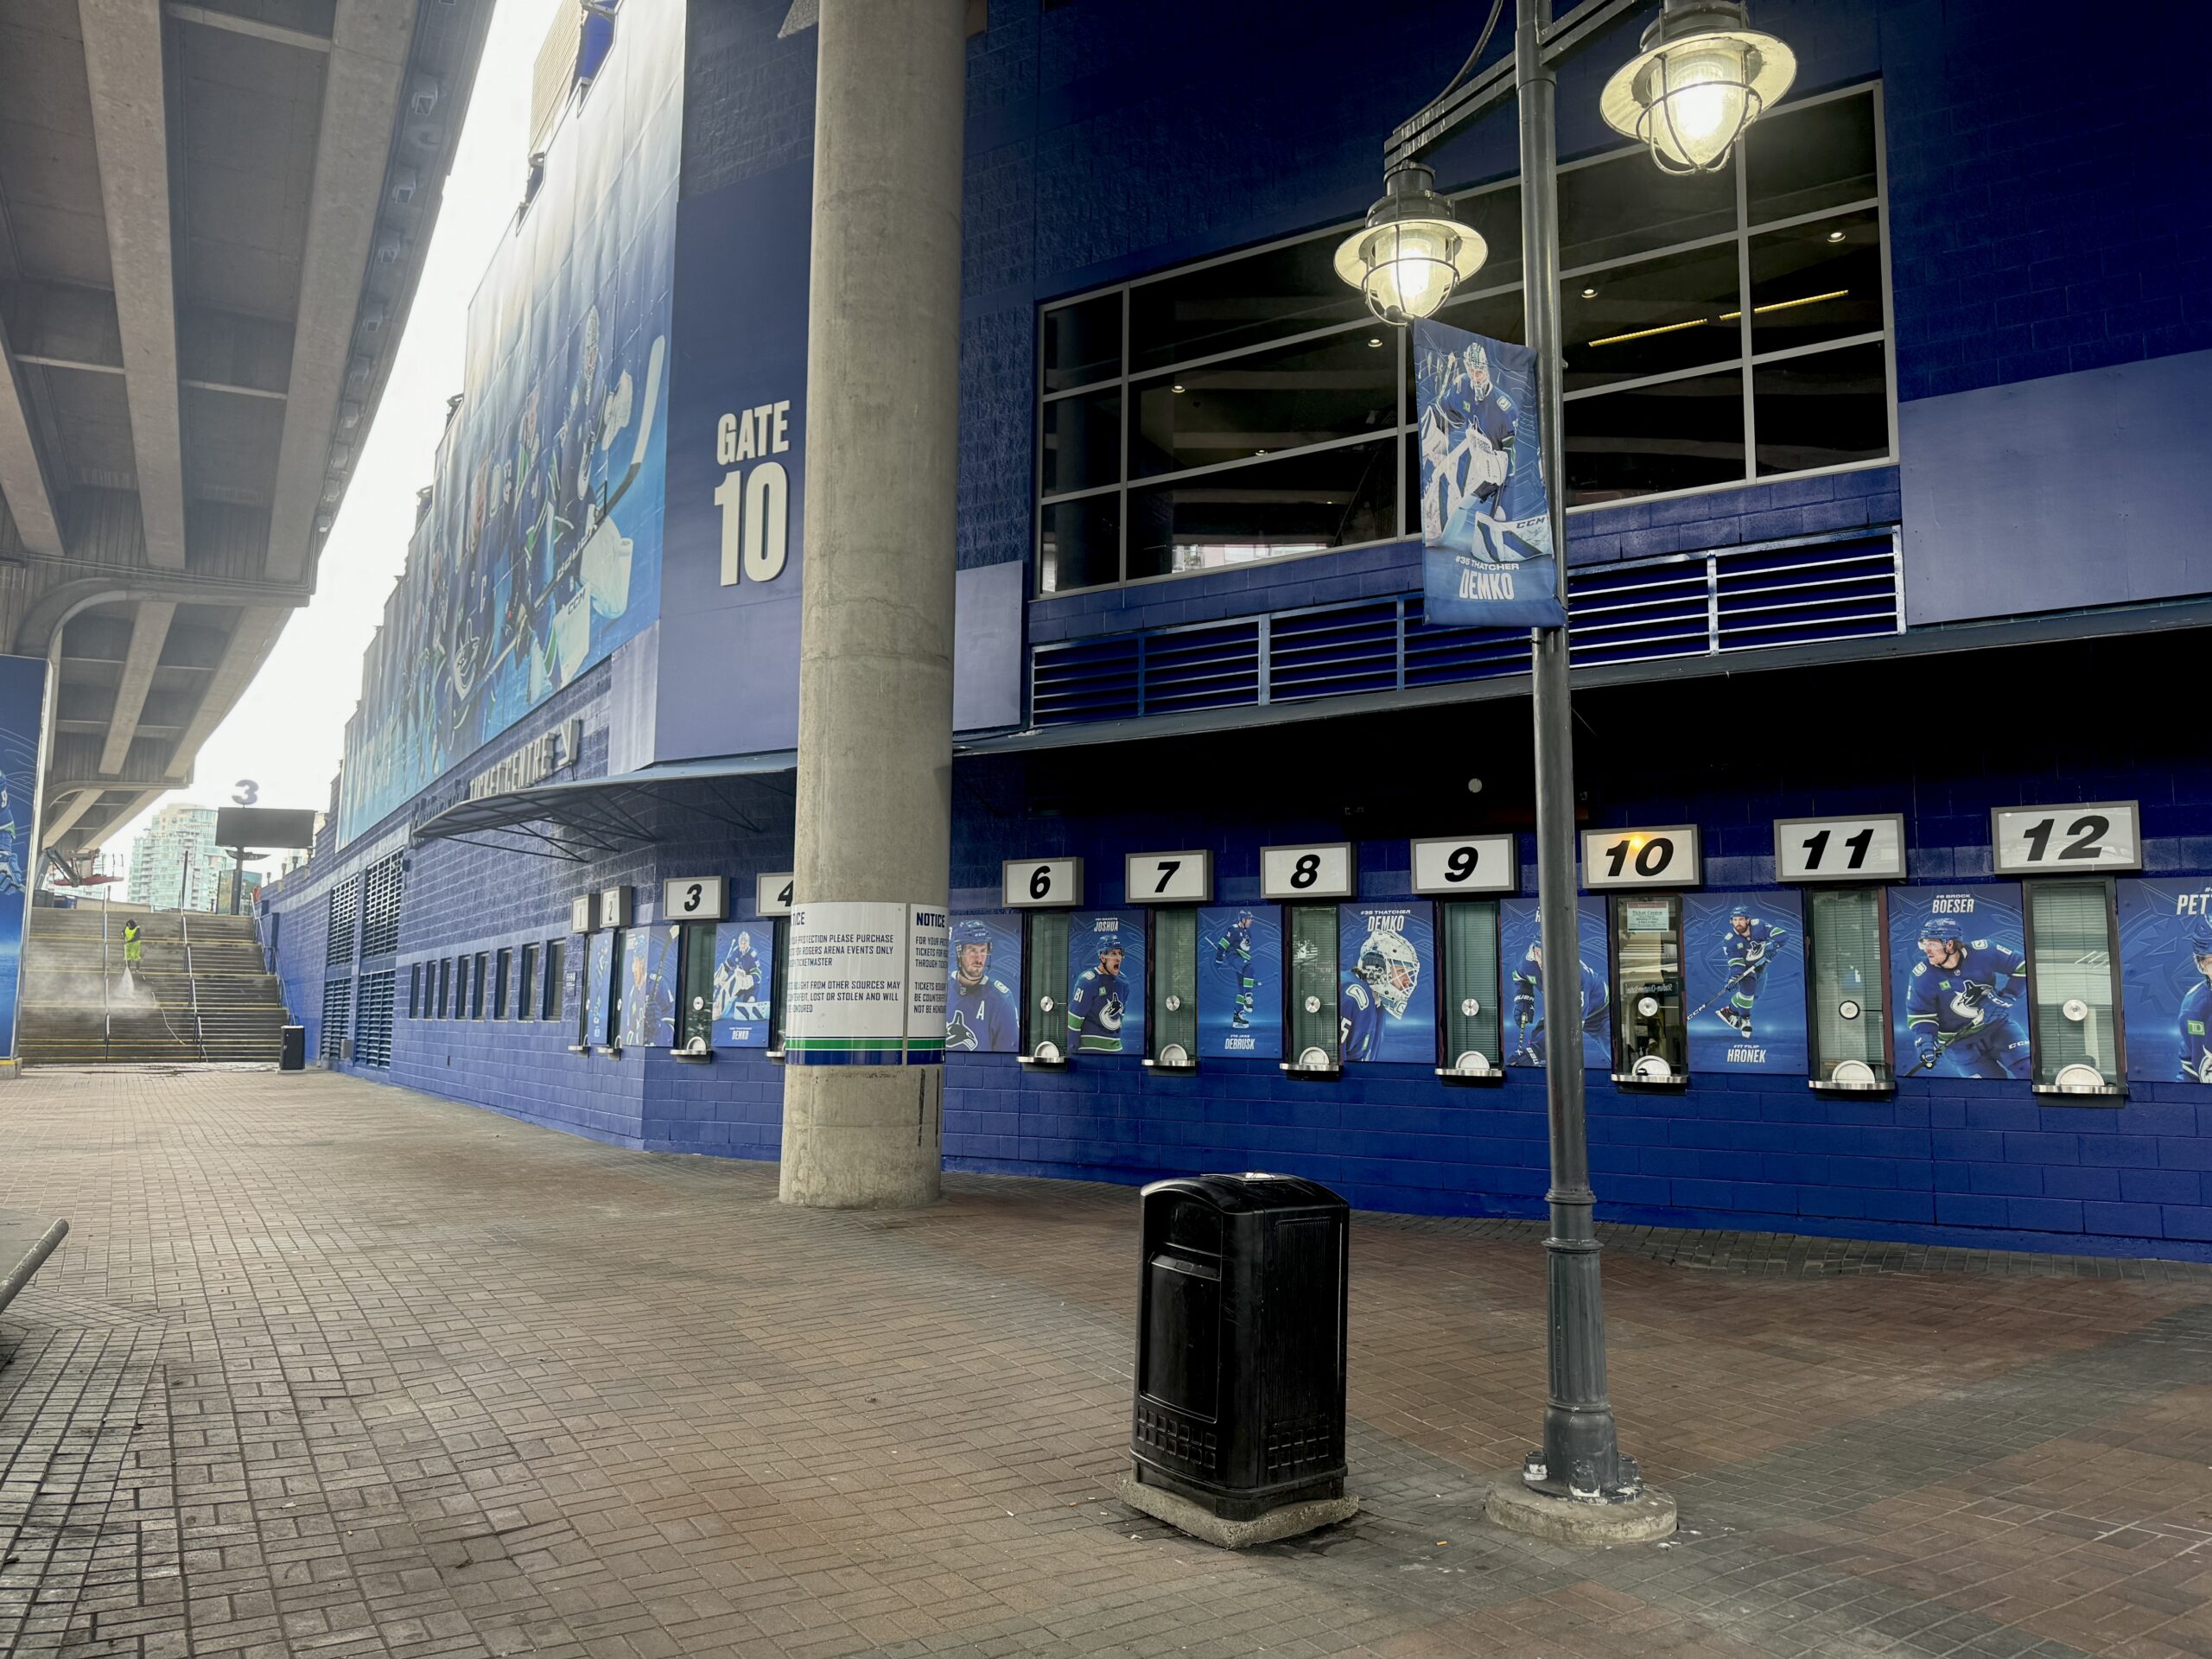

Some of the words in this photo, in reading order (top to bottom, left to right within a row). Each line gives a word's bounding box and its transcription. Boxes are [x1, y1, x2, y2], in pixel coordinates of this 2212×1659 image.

[717, 400, 790, 465] GATE
[715, 461, 787, 586] 10
[1516, 517, 1545, 529] CCM
[1455, 556, 1470, 565] #35
[1471, 557, 1520, 570] THATCHER
[1459, 569, 1515, 600] DEMKO
[505, 732, 555, 791] CENTRE
[231, 779, 259, 805] 3
[2024, 816, 2109, 861] 12
[1606, 838, 1674, 876] 10
[1802, 830, 1873, 869] 11
[1291, 855, 1321, 888] 8
[1445, 847, 1478, 882] 9
[1030, 866, 1052, 899] 6
[1154, 861, 1180, 893] 7
[683, 883, 702, 912] 3
[778, 880, 793, 907] 4
[608, 899, 613, 922] 2
[1932, 899, 1974, 913] BOESER
[2177, 894, 2212, 915] PET
[579, 907, 582, 927] 1
[790, 912, 805, 925] TICE
[916, 912, 945, 928] NOTICE
[1367, 915, 1405, 932] DEMKO
[1094, 920, 1119, 932] JOSHUA
[829, 934, 855, 944] PLEASE
[856, 934, 894, 944] PURCHASE
[916, 936, 926, 944] FOR
[927, 937, 939, 945] YOUR
[802, 946, 823, 956] ROGERS
[823, 946, 845, 955] ARENA
[847, 945, 874, 955] EVENTS
[876, 945, 894, 955] ONLY
[915, 948, 936, 957] TICKETS
[915, 959, 938, 969] THROUGH
[810, 981, 826, 989] FROM
[828, 981, 849, 989] OTHER
[851, 981, 885, 989] SOURCES
[887, 981, 901, 989] MAY
[915, 982, 935, 991] TICKETS
[810, 993, 825, 1001] LOST
[826, 993, 836, 1001] OR
[836, 993, 864, 1001] STOLEN
[866, 993, 881, 1001] AND
[882, 992, 899, 1001] WILL
[914, 993, 922, 1002] BE
[1074, 988, 1084, 1003] 81
[913, 1005, 925, 1014] NOT
[925, 1005, 932, 1014] BE
[976, 1000, 985, 1020] A
[732, 1030, 750, 1040] DEMKO
[1224, 1038, 1255, 1050] DEBRUSK
[1726, 1048, 1767, 1063] HRONEK
